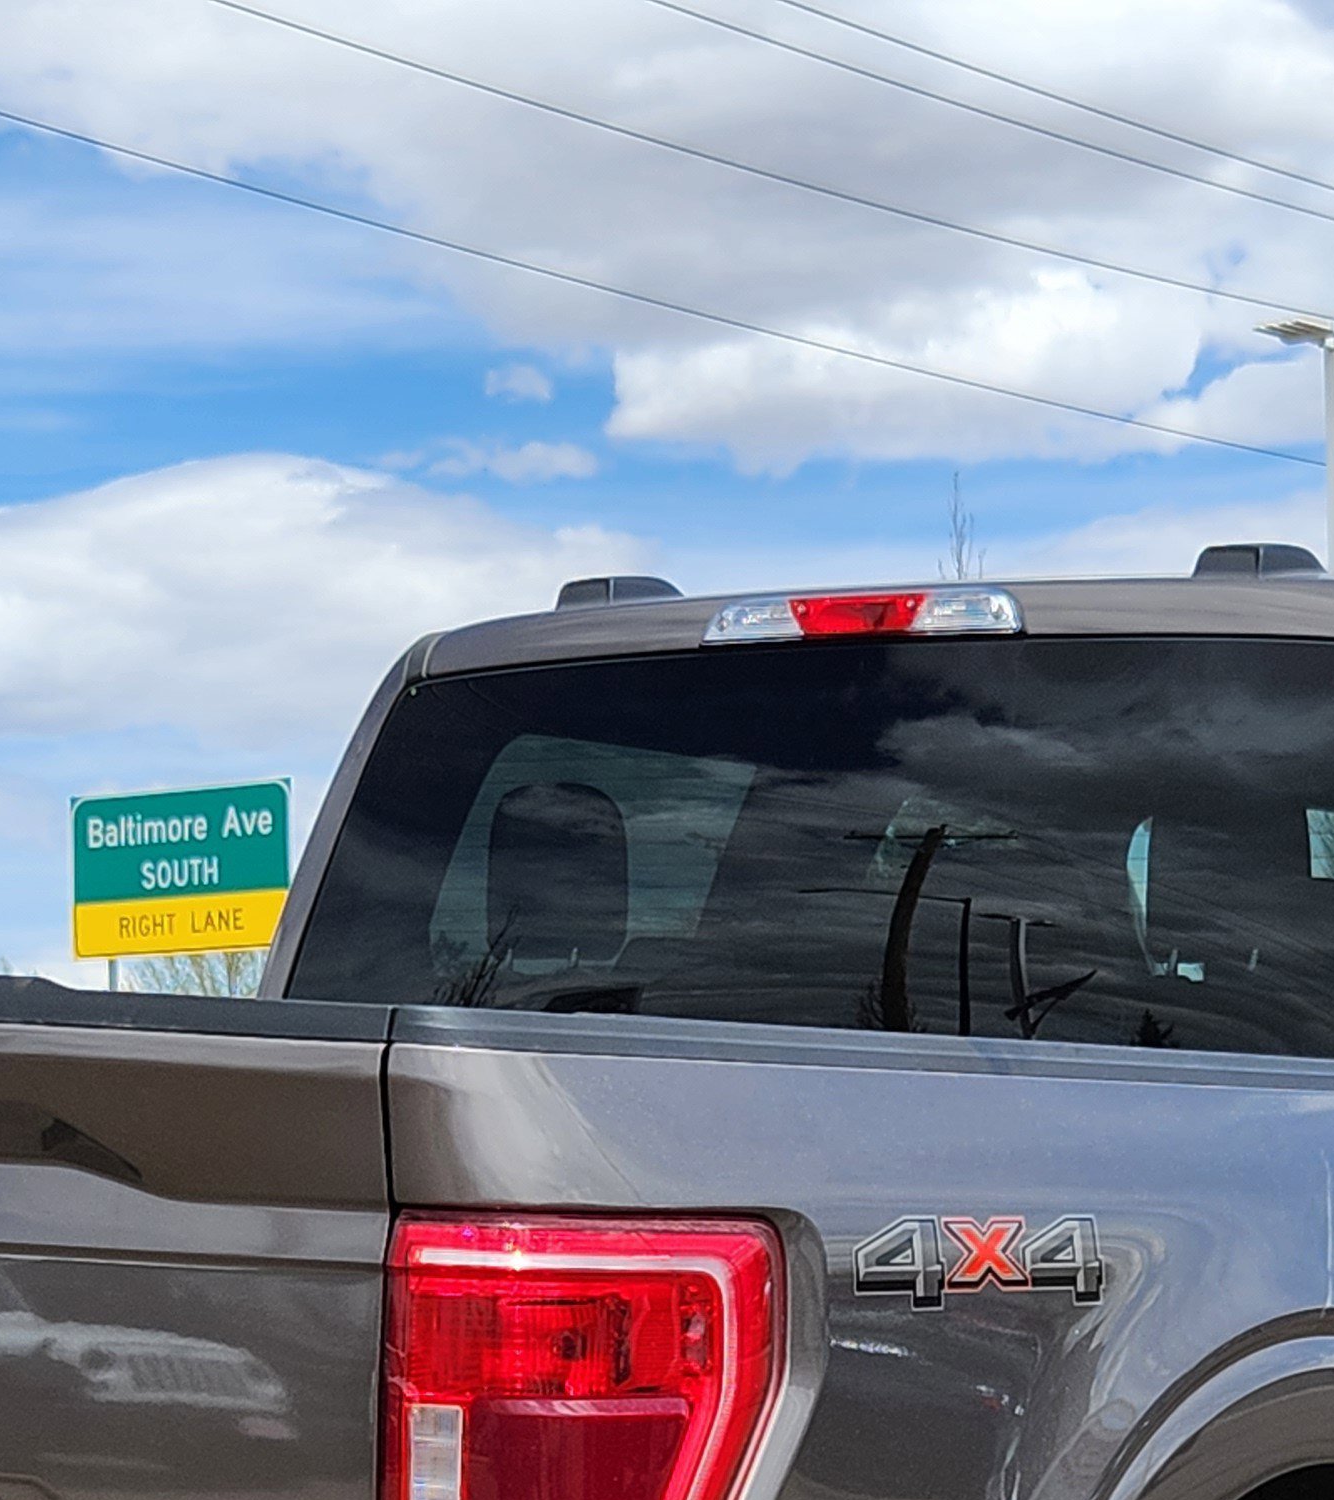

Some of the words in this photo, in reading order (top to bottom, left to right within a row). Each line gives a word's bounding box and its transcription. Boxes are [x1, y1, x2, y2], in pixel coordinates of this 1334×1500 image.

[86, 811, 207, 849] Baltimore
[221, 805, 273, 839] Ave
[140, 856, 219, 890] SOUTH
[118, 913, 176, 939] RIGHT
[191, 907, 245, 934] LANE
